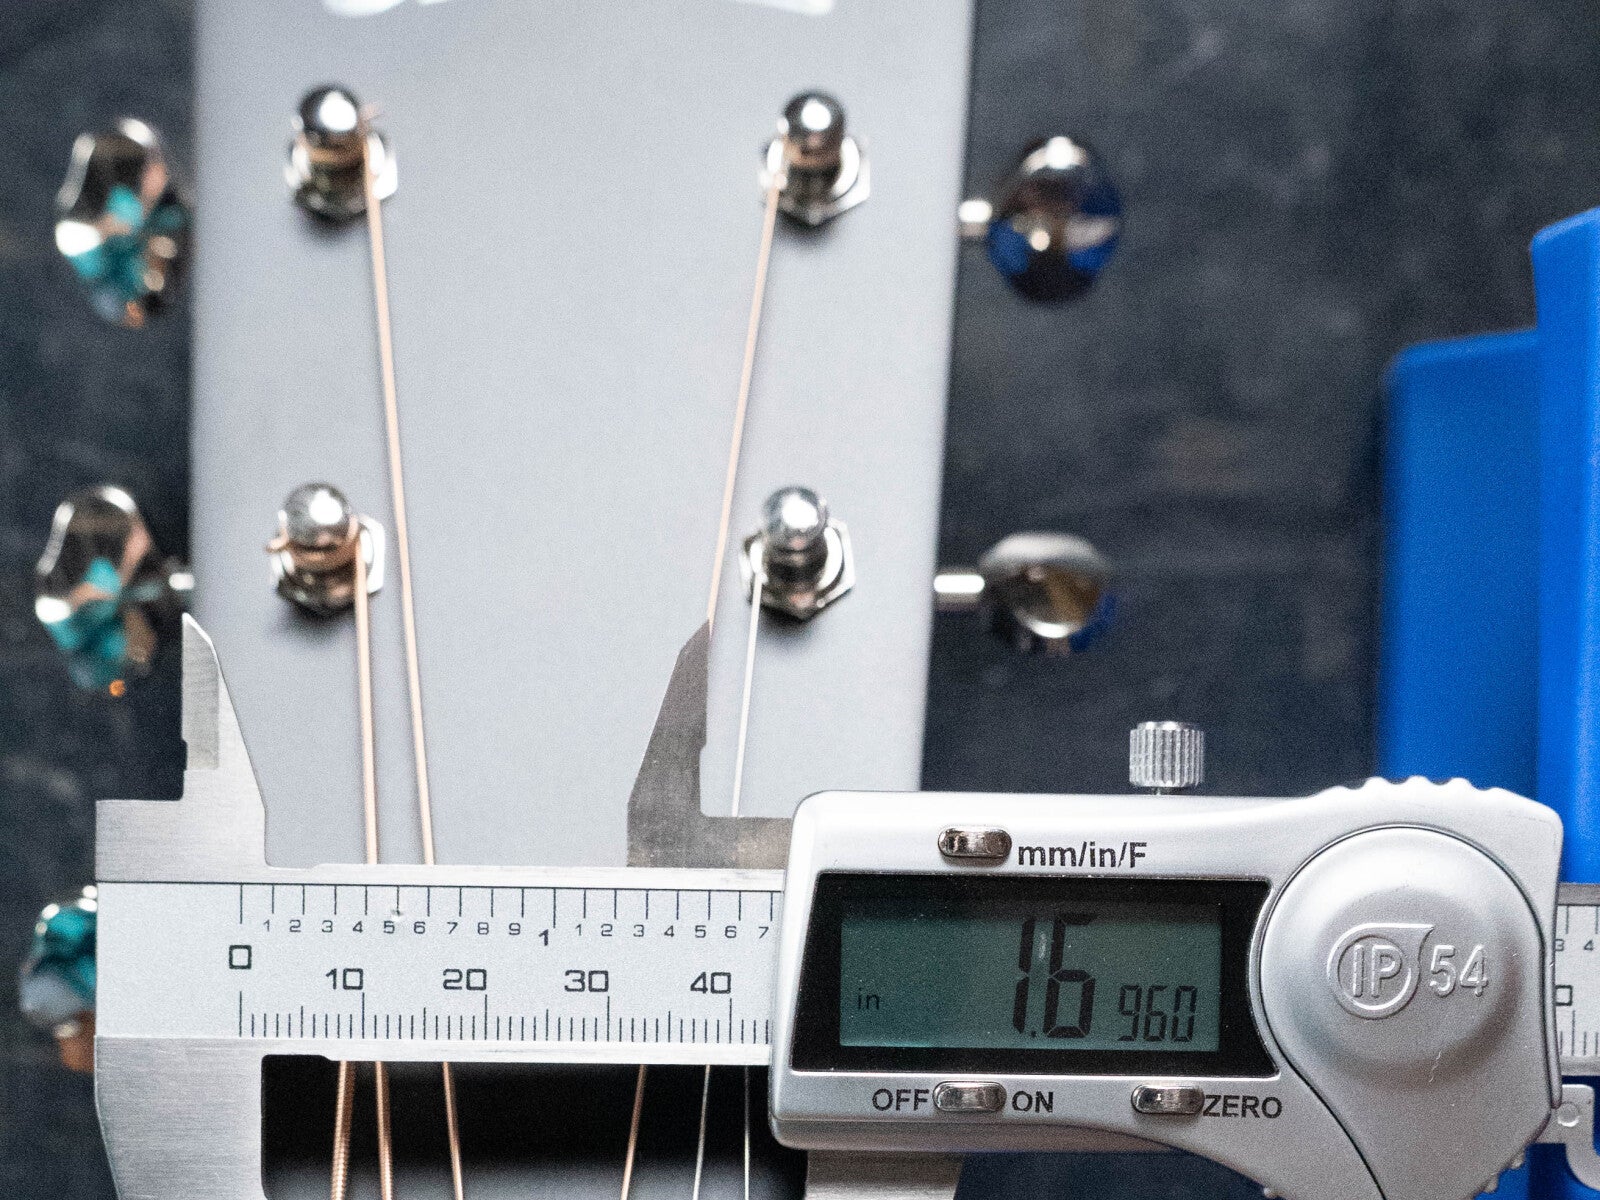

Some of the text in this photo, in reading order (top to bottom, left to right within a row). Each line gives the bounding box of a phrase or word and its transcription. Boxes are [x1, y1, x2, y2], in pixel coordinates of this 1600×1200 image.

[1017, 841, 1147, 869] mm/in/F
[263, 919, 769, 947] 1 2 3 4 5 6 7 8 9 1 1 2 3 4 5 6 7
[1583, 939, 1595, 952] 4
[228, 944, 732, 994] 0 10 20 30 40
[857, 987, 881, 1011] in
[871, 1088, 1283, 1119] OFF ON ZERO
